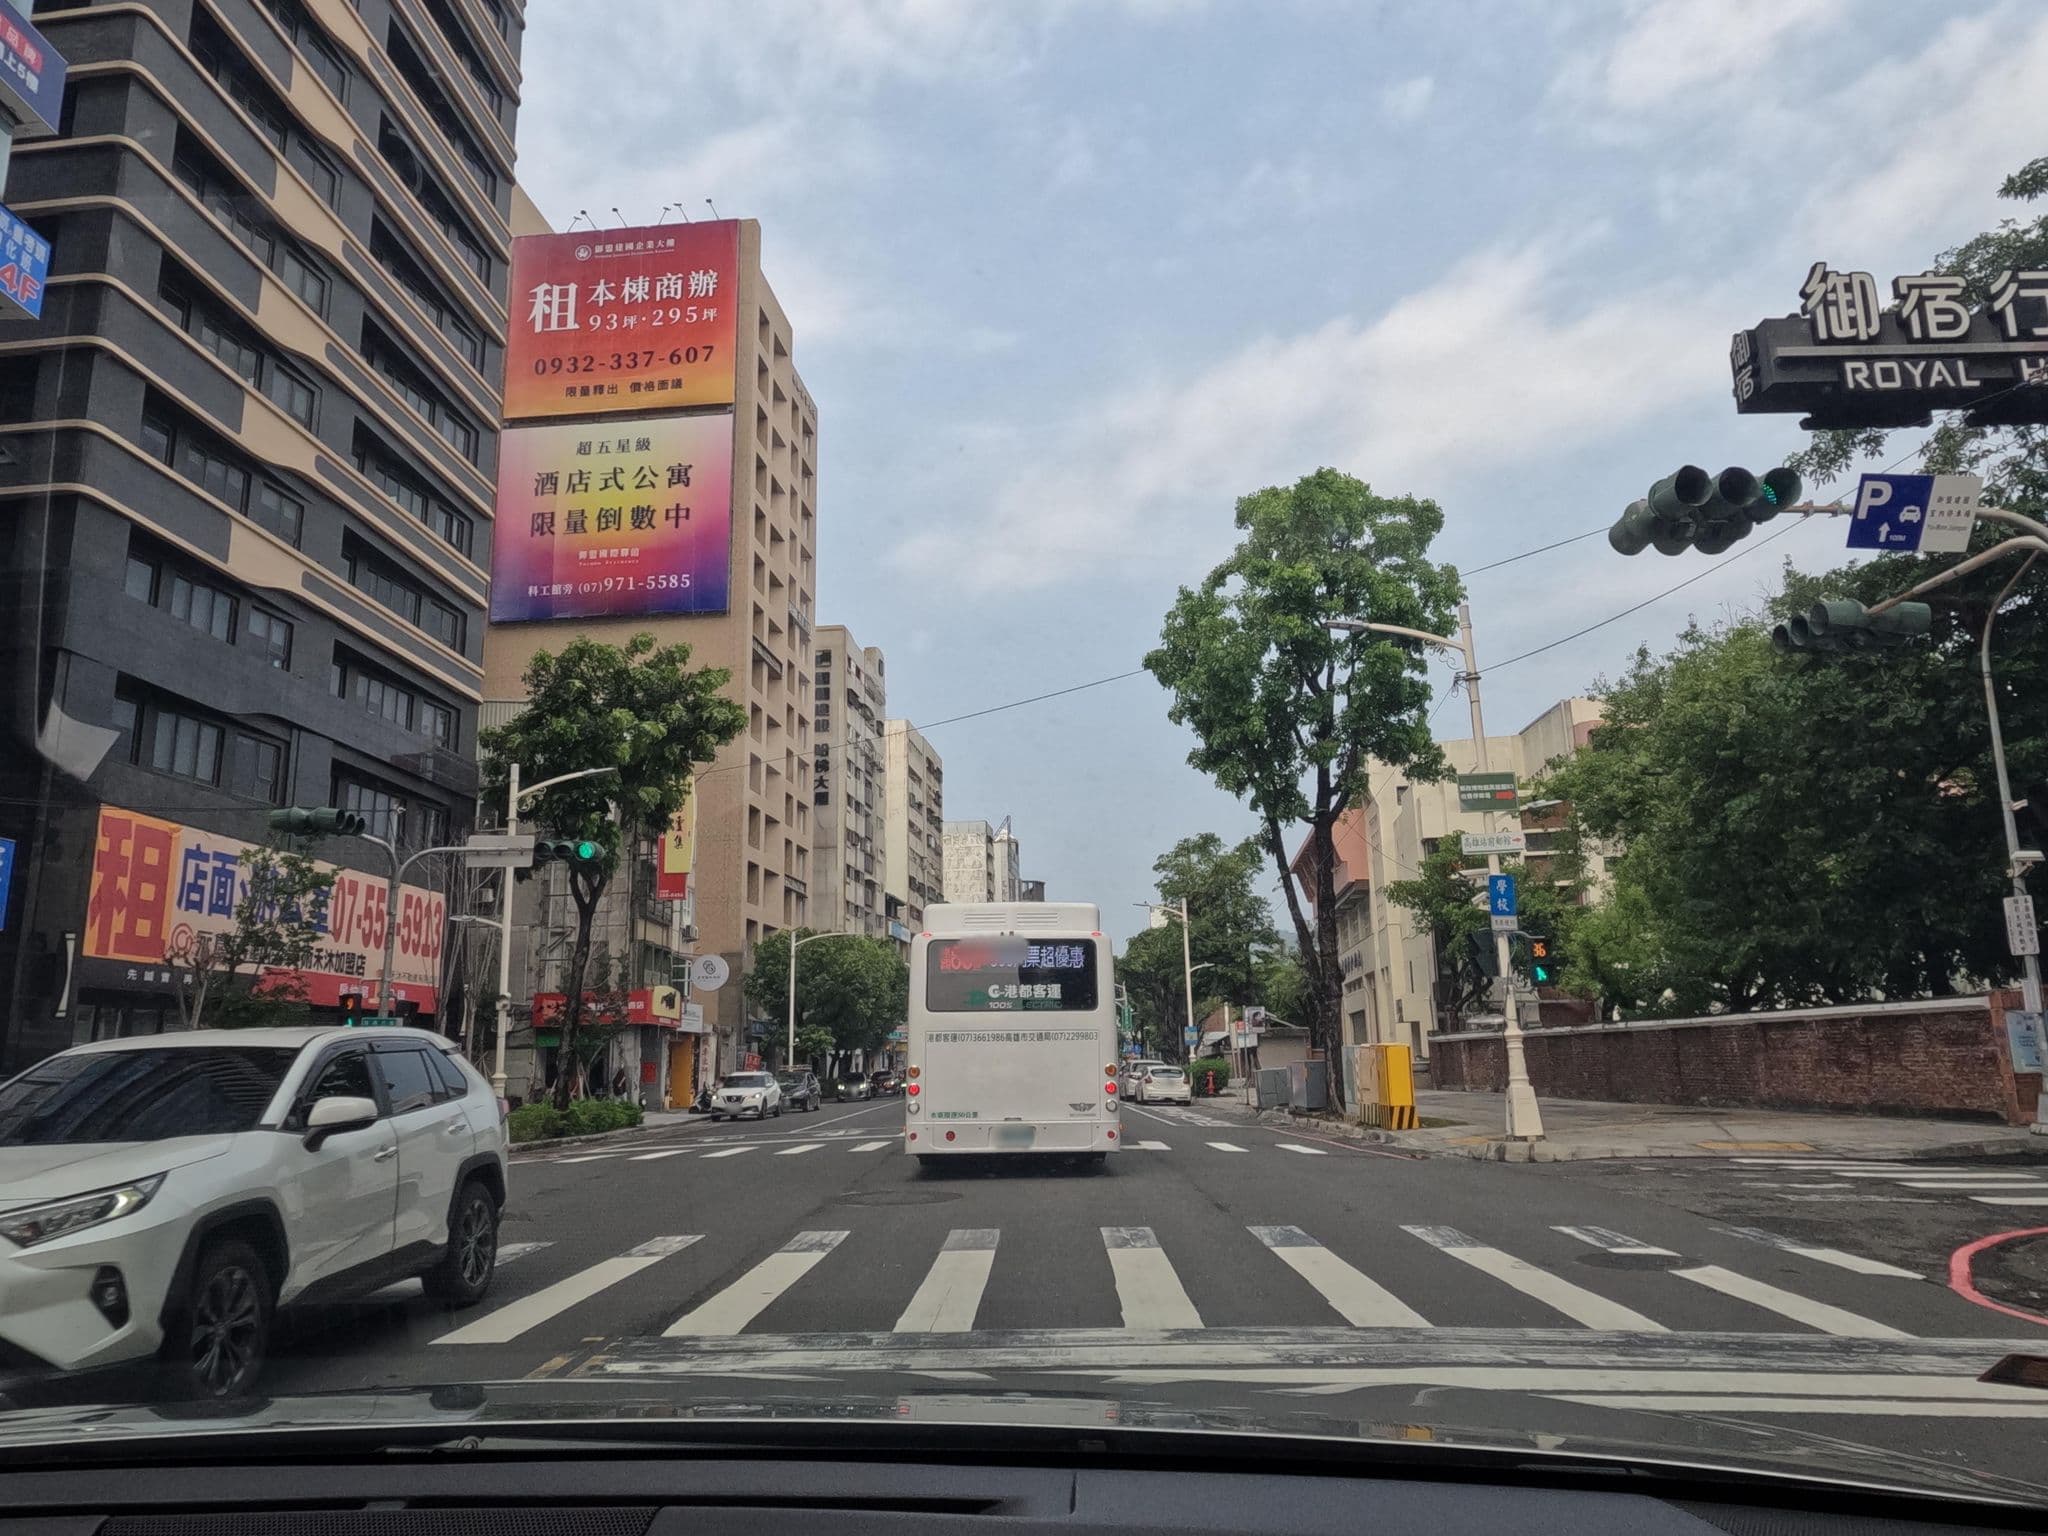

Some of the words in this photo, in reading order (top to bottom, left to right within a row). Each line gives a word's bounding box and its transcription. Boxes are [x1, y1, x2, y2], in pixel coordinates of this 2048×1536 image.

[0, 262, 40, 304] 4F
[586, 269, 718, 307] 本棟商辦
[527, 282, 580, 333] 租
[534, 345, 714, 375] 0932-337-607
[1730, 331, 1754, 402] 御宿
[1844, 360, 1981, 389] ROYAL
[565, 384, 618, 398] 限量釋出
[629, 378, 683, 393] 價格面議
[576, 437, 651, 456] 超五星級
[534, 463, 693, 496] 酒店式公寓
[1857, 481, 1893, 519] P
[530, 503, 691, 537] 限量倒數中
[528, 583, 573, 597] 科工館旁
[89, 815, 173, 959] 租
[1496, 879, 1509, 912] 學校
[332, 876, 443, 960] 07-55-5913
